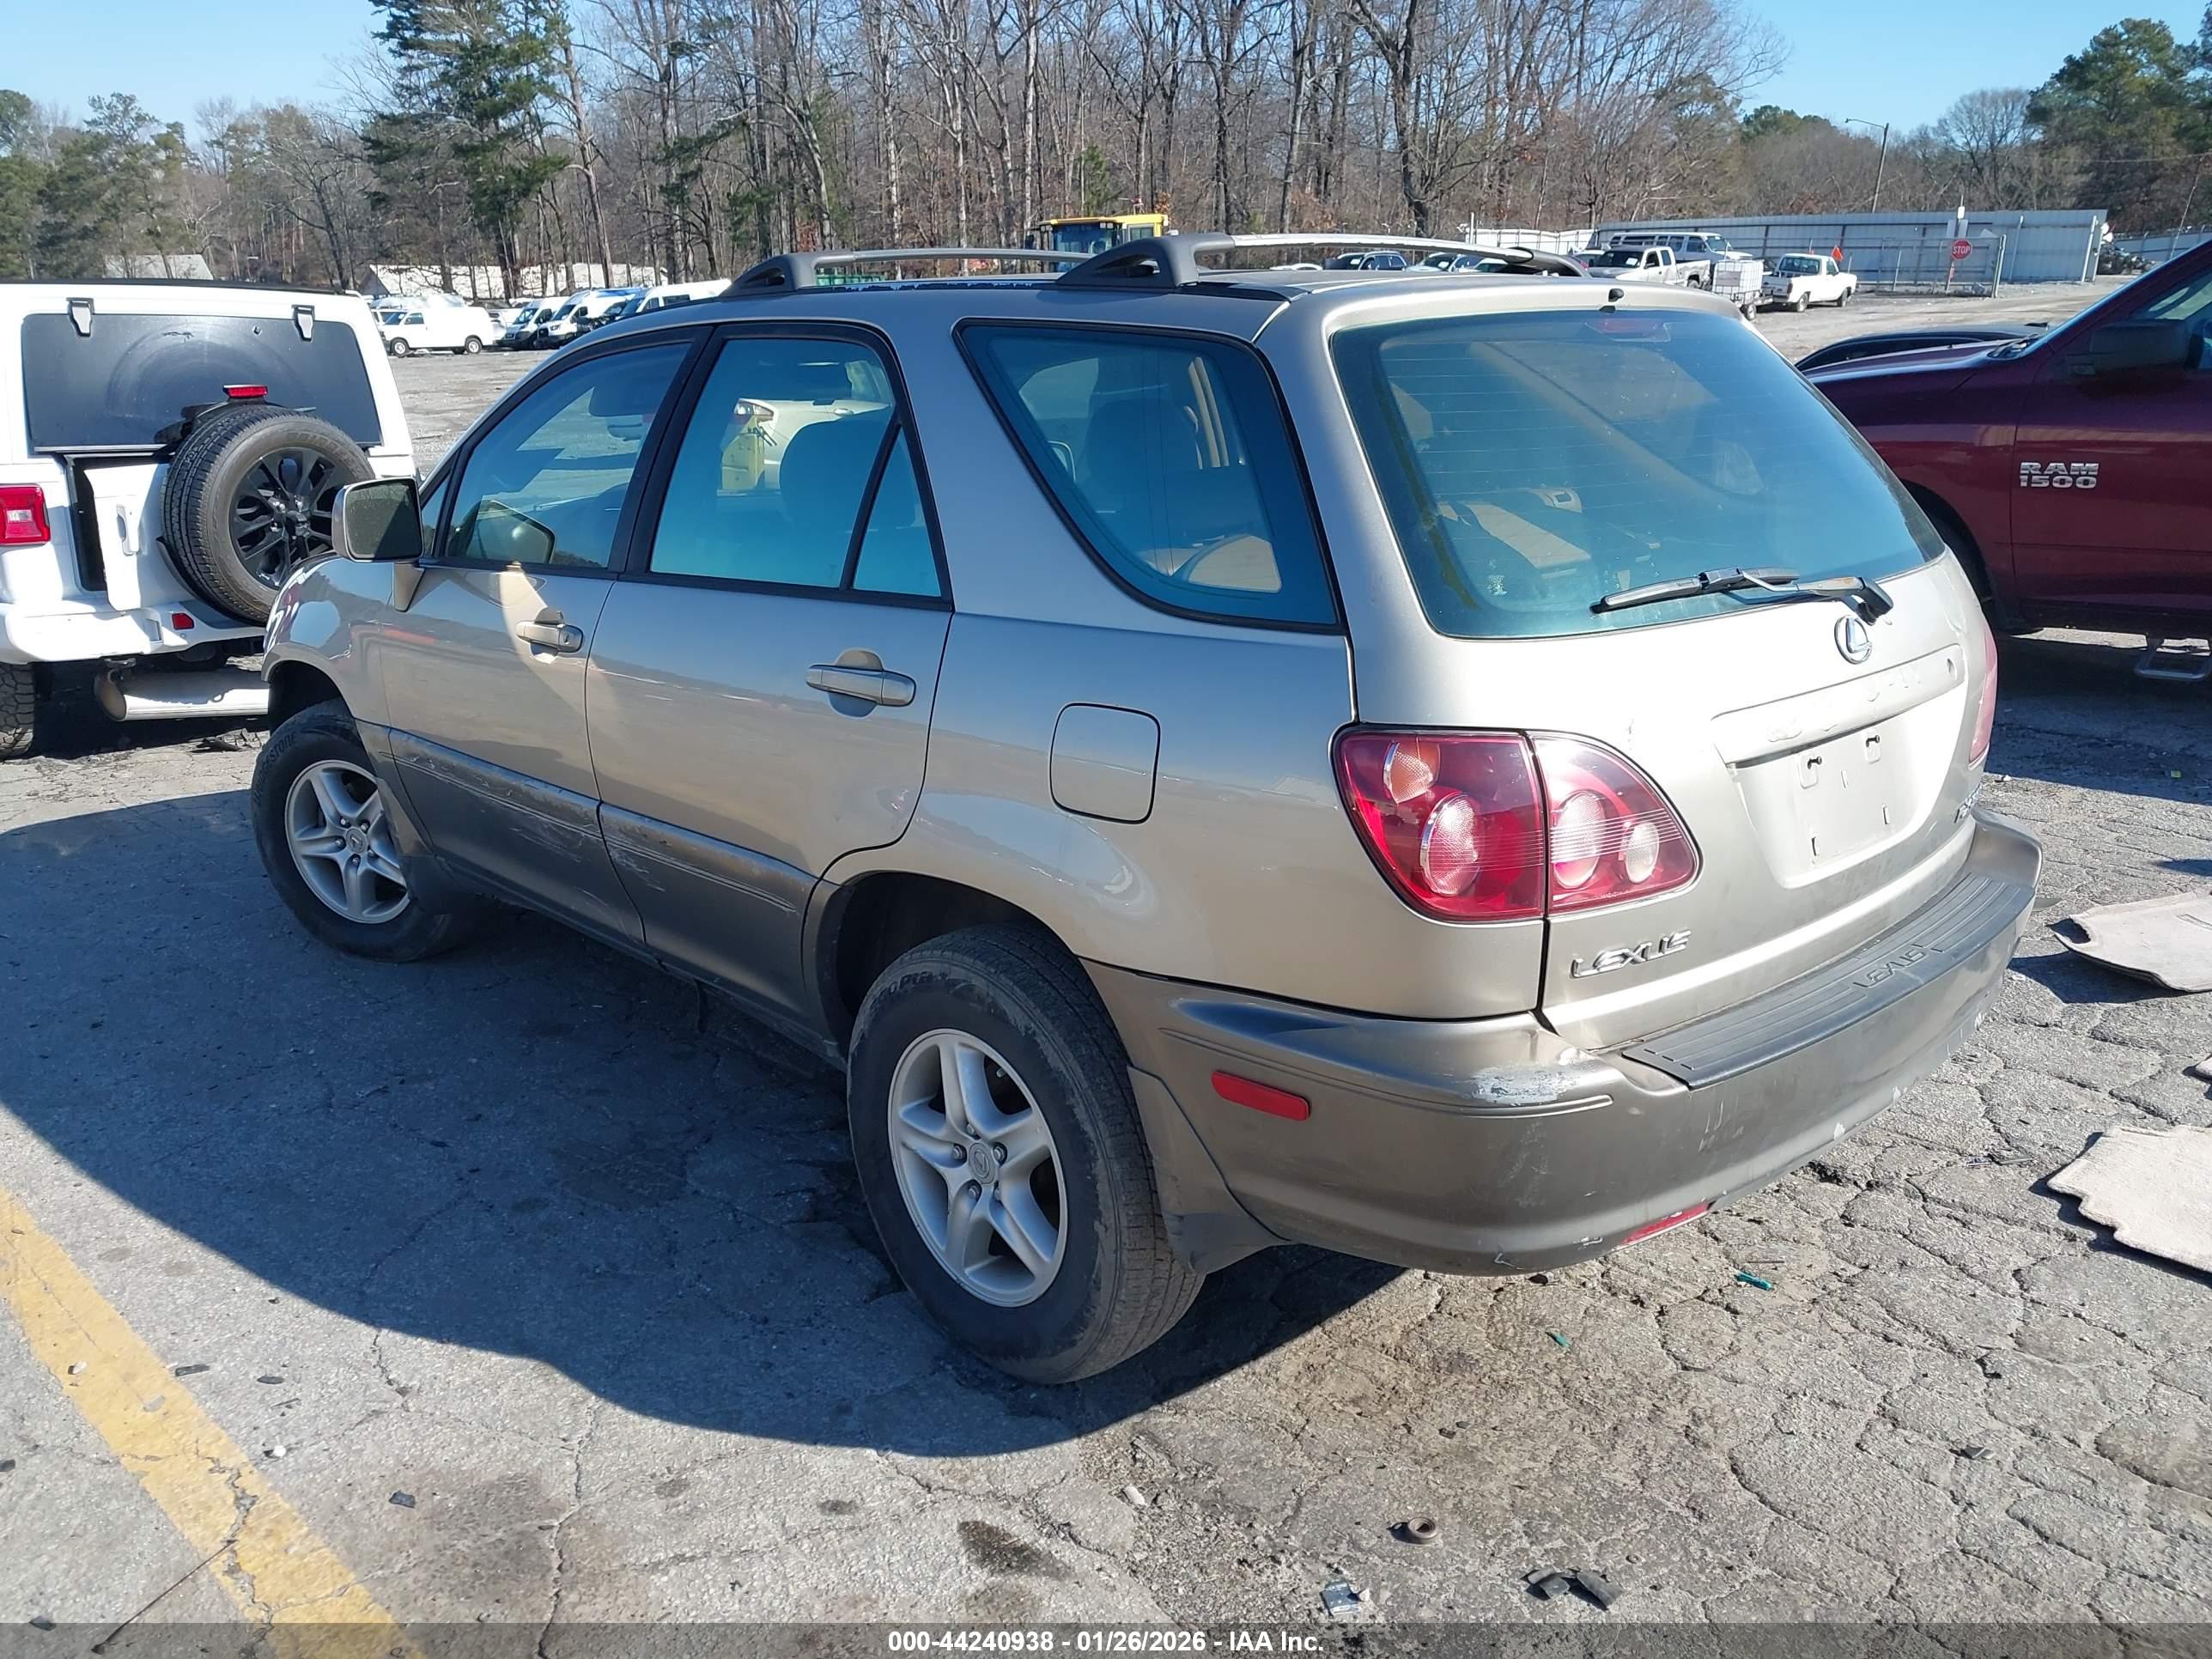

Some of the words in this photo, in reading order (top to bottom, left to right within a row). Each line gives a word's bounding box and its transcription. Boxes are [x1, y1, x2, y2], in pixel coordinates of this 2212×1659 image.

[1952, 246, 1971, 255] STOP
[2020, 462, 2100, 475] RAM
[2020, 475, 2097, 489] 1500
[1570, 929, 1692, 979] LEXUS
[1852, 948, 1928, 988] LEXUS
